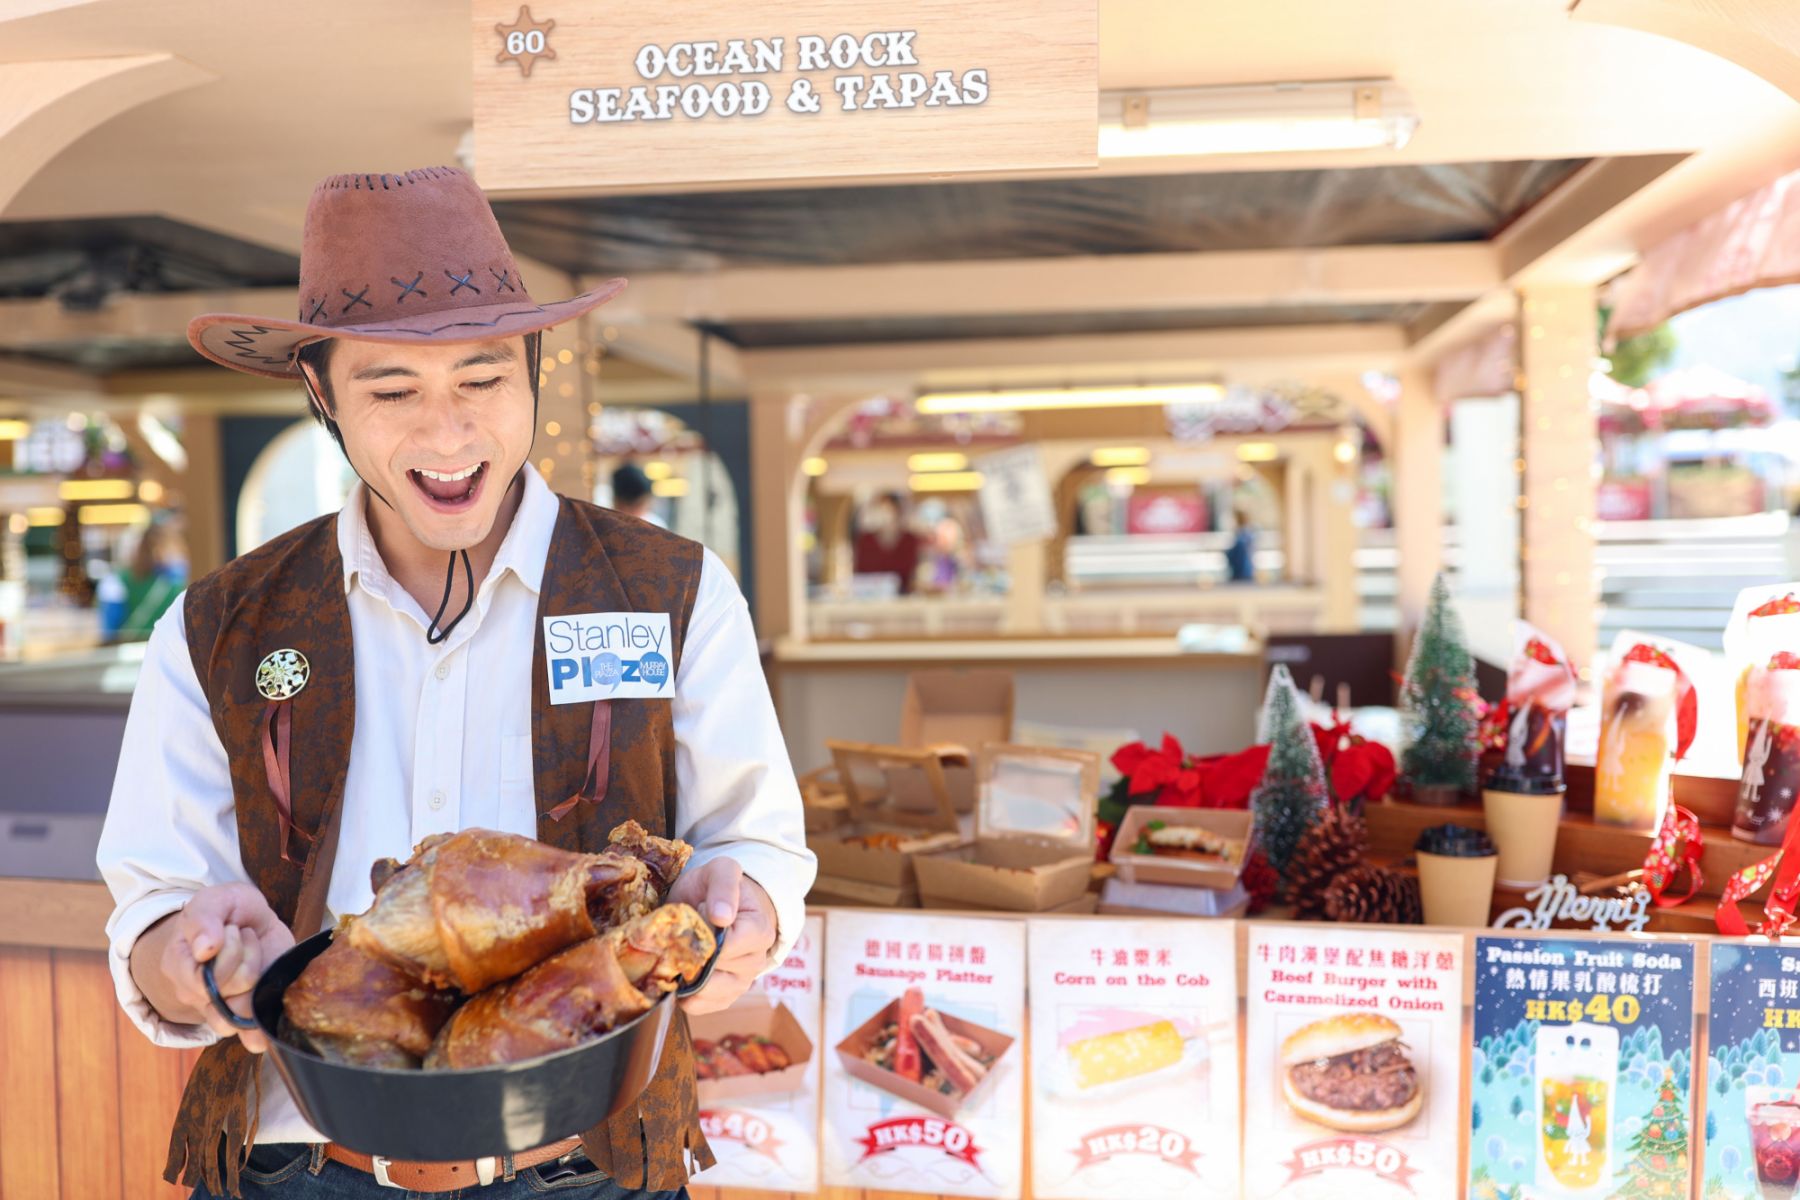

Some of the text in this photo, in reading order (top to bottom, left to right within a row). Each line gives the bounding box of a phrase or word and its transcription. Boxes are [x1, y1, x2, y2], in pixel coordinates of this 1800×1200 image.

[506, 31, 545, 55] 60
[635, 30, 917, 79] OCEAN ROCK
[569, 69, 989, 125] SEAFOOD & TAPAS
[549, 617, 665, 653] Stanley
[1486, 946, 1682, 970] Passion Fruit Soda
[855, 963, 994, 984] Sausage Platter
[1054, 972, 1209, 987] Corn on the Cob
[1271, 970, 1438, 991] Beef Burger with
[1264, 990, 1444, 1011] Caramelized Onion
[1758, 977, 1799, 999] 西班
[1525, 994, 1641, 1024] HK$40
[875, 1121, 970, 1152] HK$50
[1087, 1126, 1185, 1157] HK$20
[1302, 1141, 1401, 1174] HK$50
